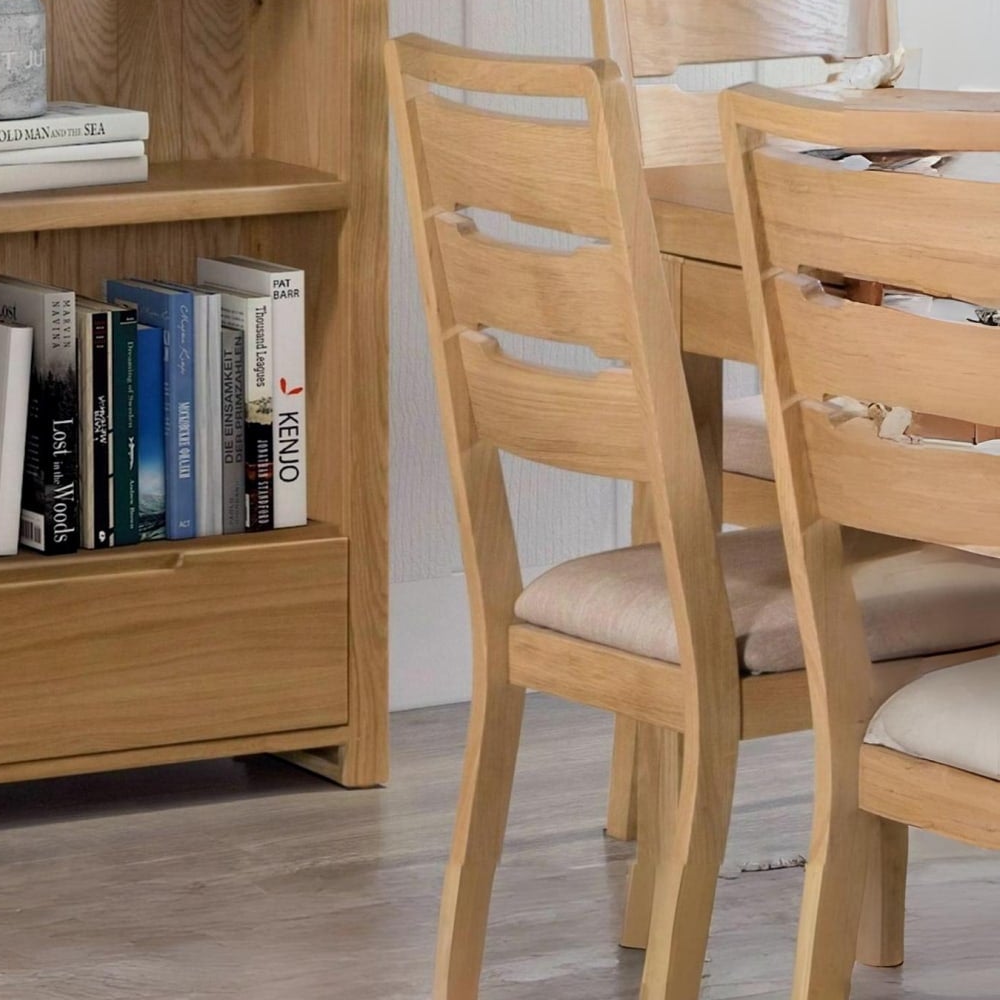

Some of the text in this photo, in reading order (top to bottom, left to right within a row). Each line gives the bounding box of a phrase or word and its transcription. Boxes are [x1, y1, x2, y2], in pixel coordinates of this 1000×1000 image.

[25, 126, 50, 141] MAN
[51, 128, 67, 138] AND
[67, 127, 82, 137] THE
[84, 122, 106, 136] SEA
[273, 279, 291, 288] PAT
[273, 289, 300, 300] BARR
[52, 301, 60, 349] NAVINA
[63, 300, 71, 348] MARVIN
[253, 305, 267, 387] Thousand Leagues
[223, 350, 233, 464] DIE EINSAMKEIT
[234, 336, 243, 464] DER PRIMZAHLEN
[278, 412, 300, 483] KENJO
[52, 418, 75, 543] Lost in the Woods
